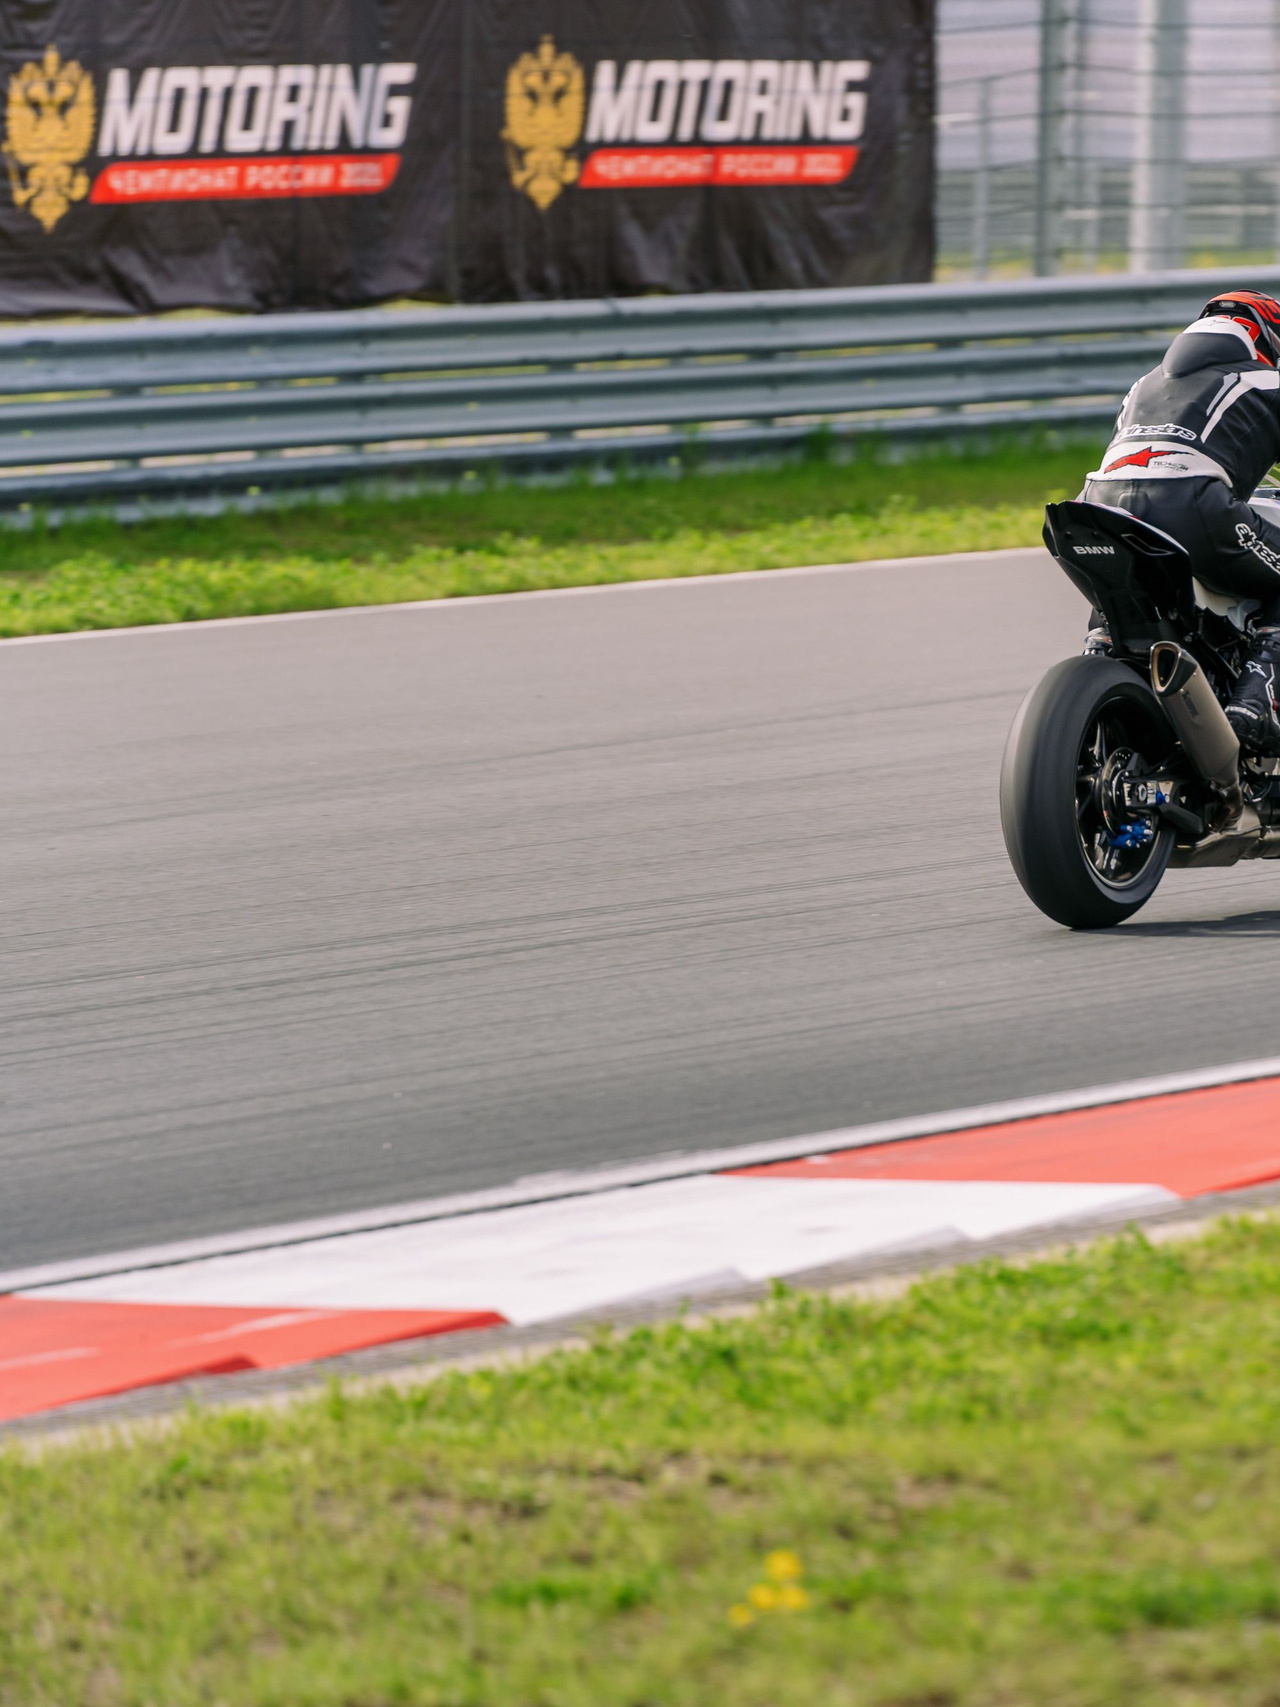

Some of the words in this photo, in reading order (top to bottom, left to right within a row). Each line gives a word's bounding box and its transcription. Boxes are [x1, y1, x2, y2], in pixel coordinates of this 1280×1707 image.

[97, 62, 418, 157] MOTORING
[584, 59, 872, 143] MOTORING
[106, 165, 239, 195] ЧЕМПИОНАТ
[245, 162, 336, 190] РОССИИ
[1072, 545, 1116, 555] BMW
